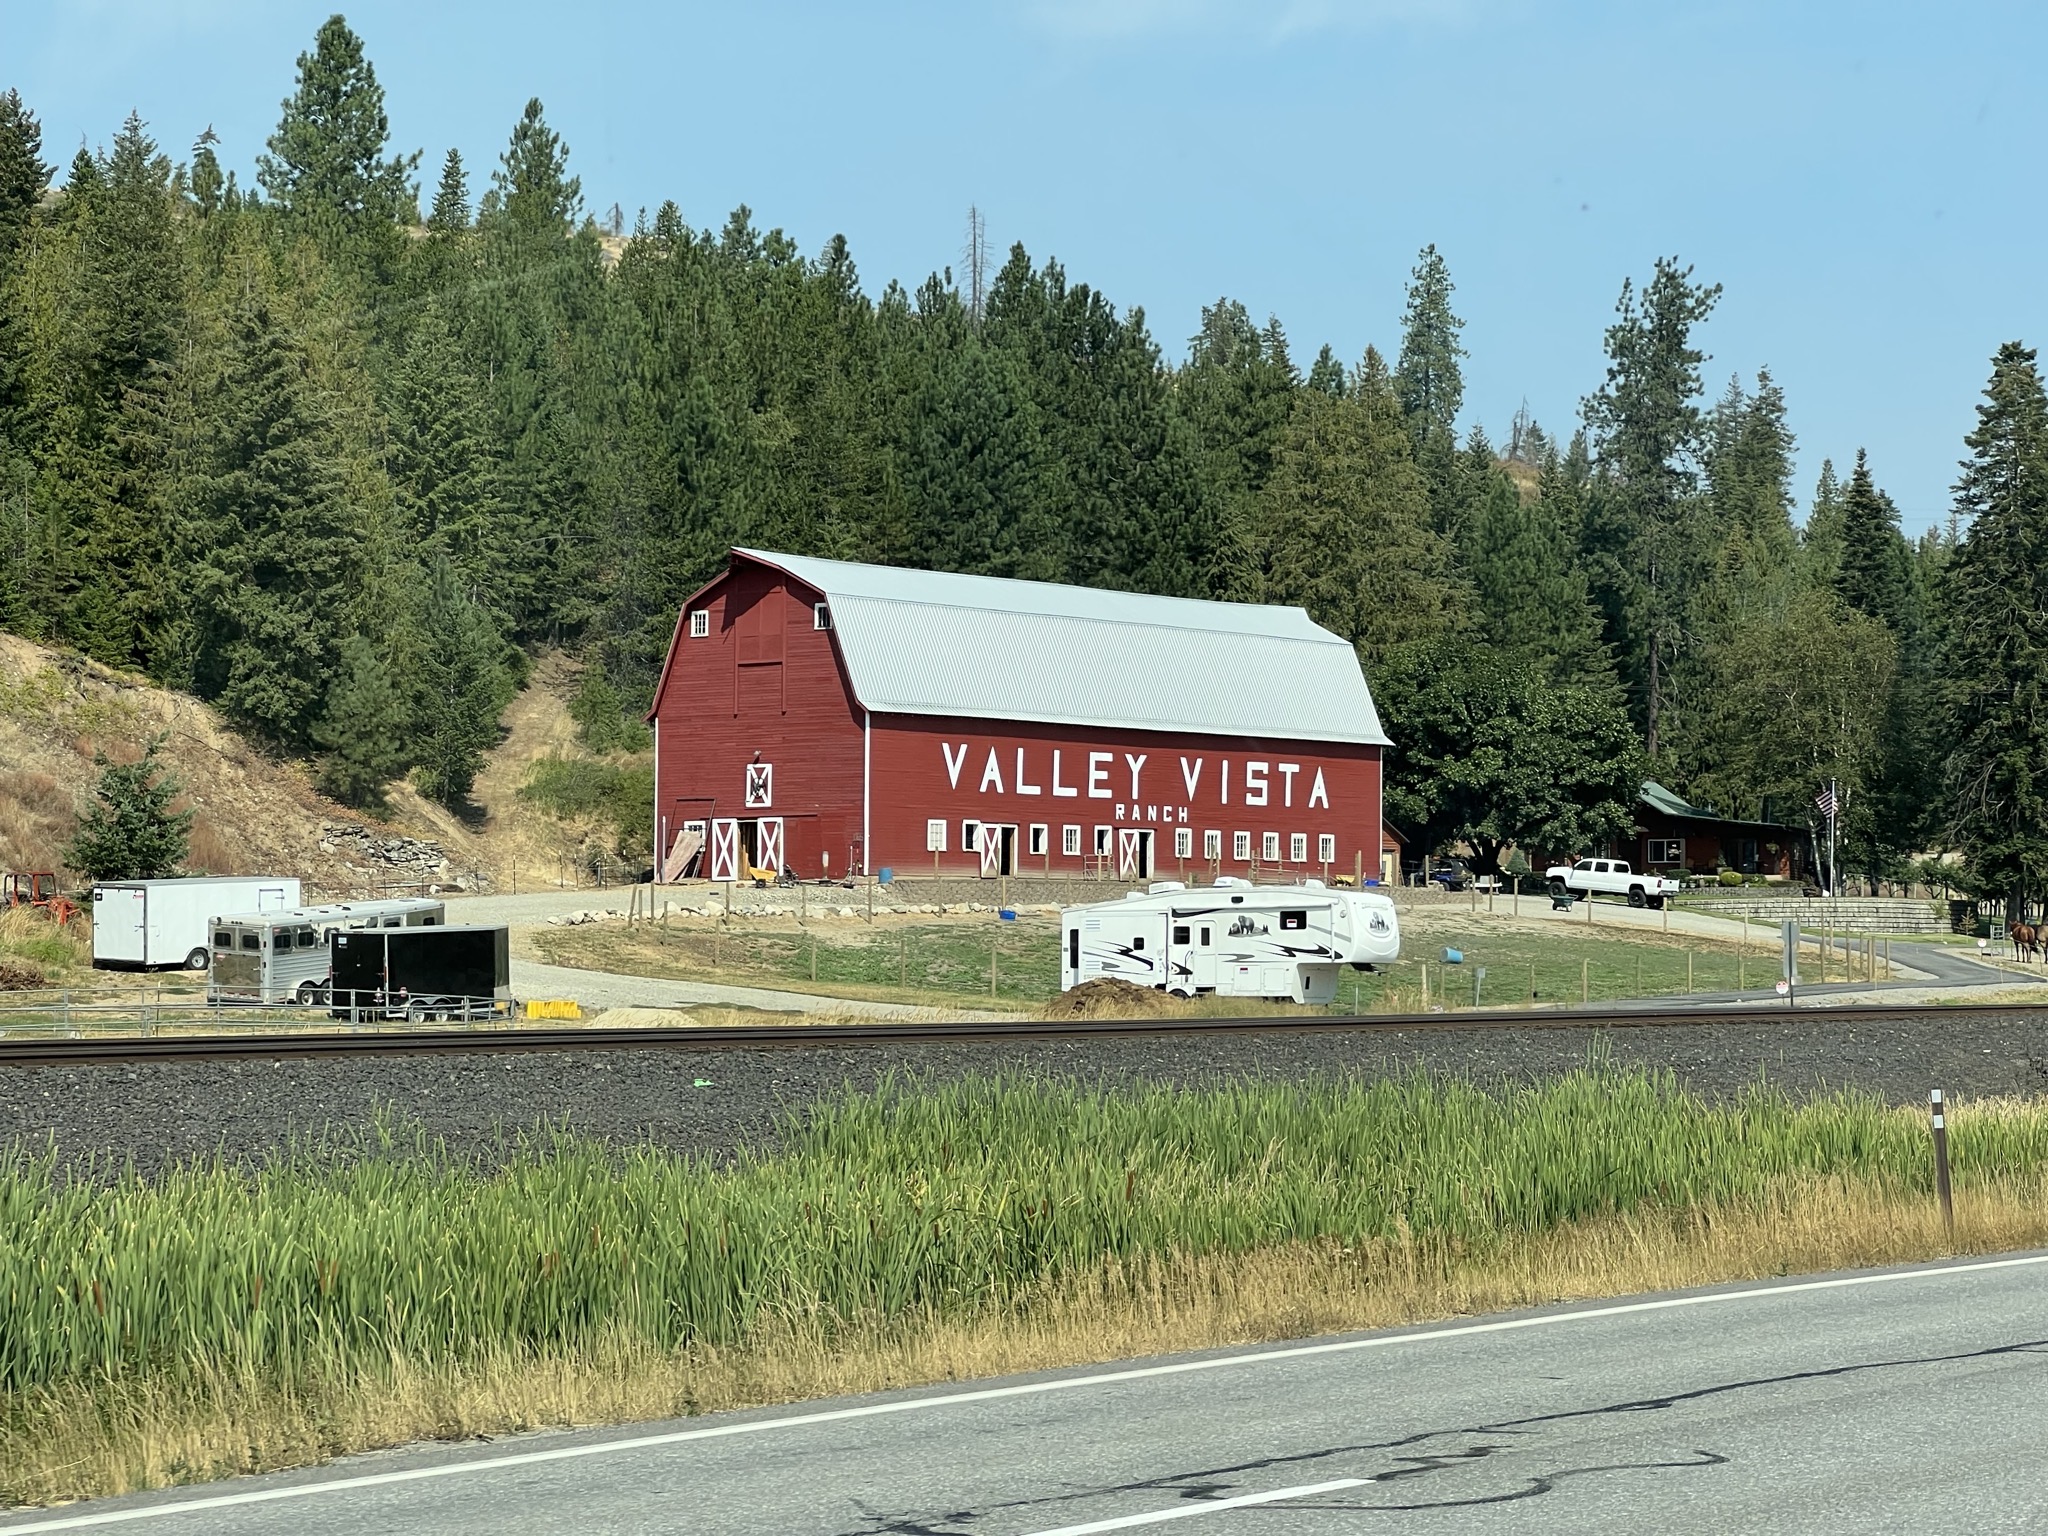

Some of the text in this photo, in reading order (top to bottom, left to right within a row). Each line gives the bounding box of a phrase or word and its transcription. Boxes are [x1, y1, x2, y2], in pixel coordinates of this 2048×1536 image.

[941, 742, 1330, 809] VALLEY VISTA
[1115, 803, 1189, 823] RANCH
